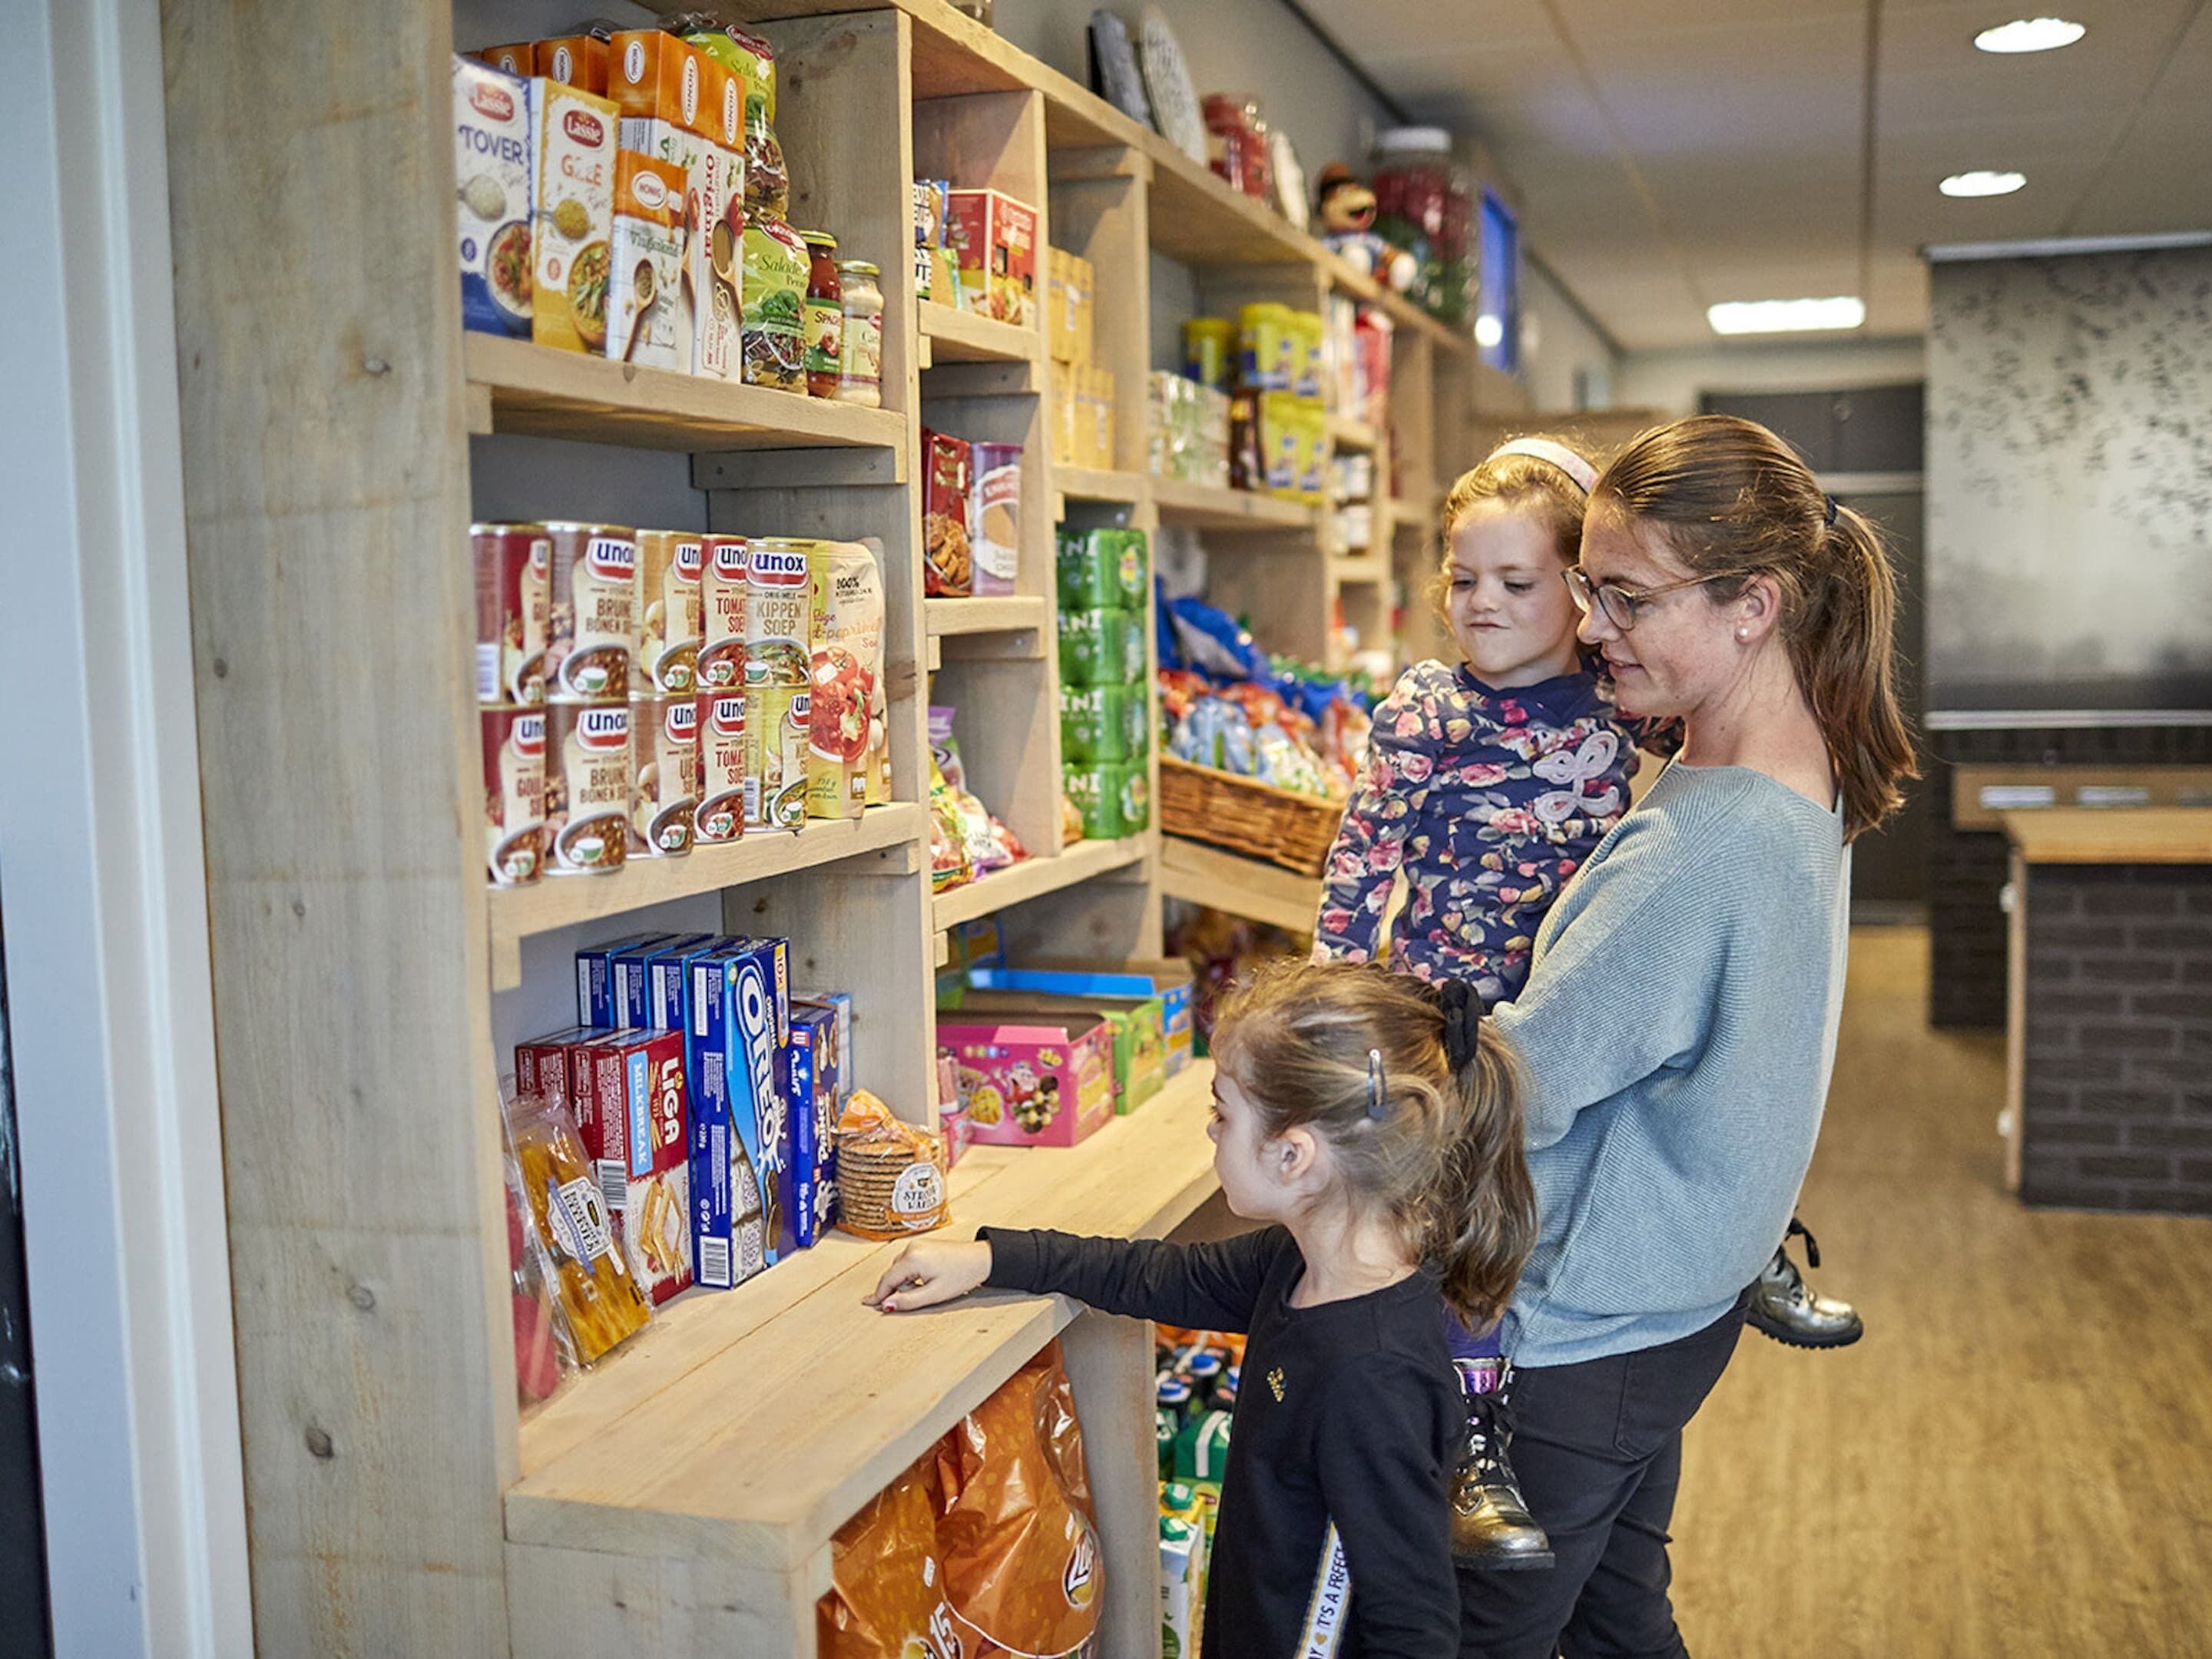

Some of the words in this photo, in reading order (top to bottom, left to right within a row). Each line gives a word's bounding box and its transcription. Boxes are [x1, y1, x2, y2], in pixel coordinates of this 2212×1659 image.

[459, 125, 524, 165] TOVER
[566, 115, 601, 144] Lassie
[703, 154, 716, 259] Original
[756, 553, 804, 571] unox
[757, 602, 800, 618] KIPPEN
[763, 620, 796, 636] SOEP
[736, 966, 775, 1147] OREO
[634, 1063, 647, 1164] MILKBREAK
[661, 1058, 682, 1144] LIGA
[1329, 1584, 1337, 1603] A
